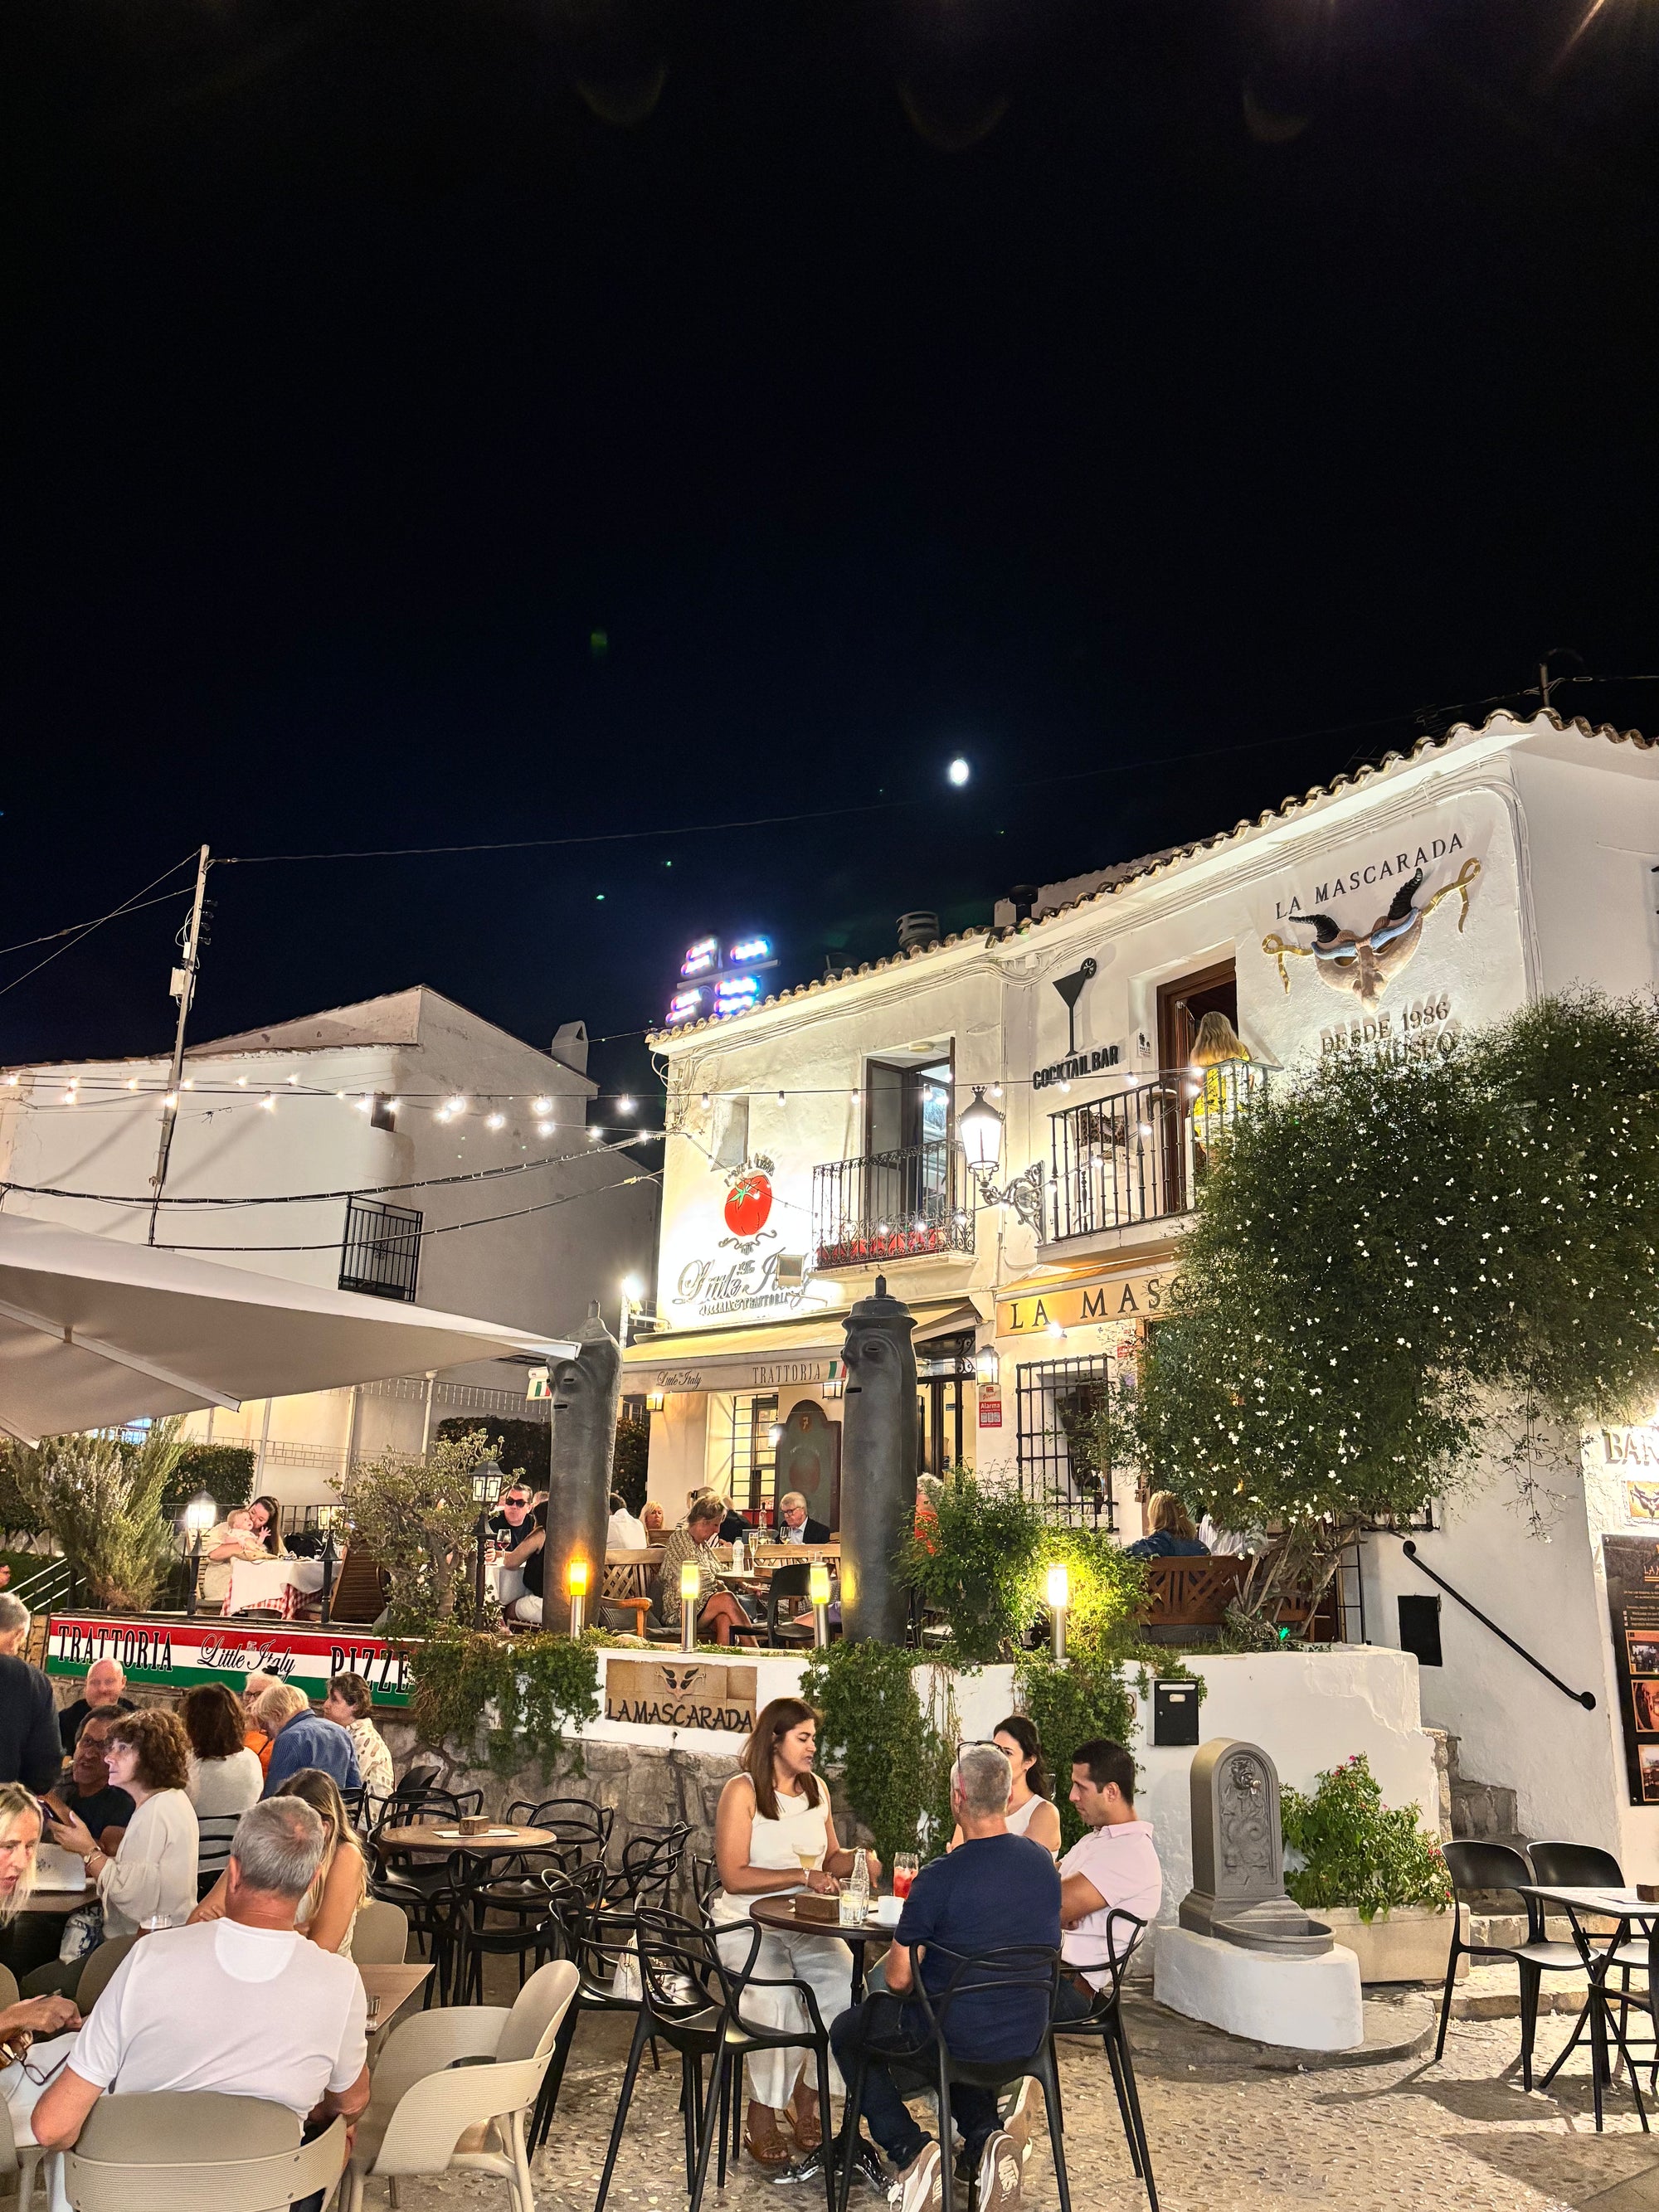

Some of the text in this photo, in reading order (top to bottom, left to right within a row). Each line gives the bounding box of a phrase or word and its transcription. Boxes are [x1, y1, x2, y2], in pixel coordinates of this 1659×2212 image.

[1275, 833, 1463, 920] LA MASCARADA
[1321, 1001, 1449, 1056] DESDE 1986
[1033, 1045, 1119, 1090] COCKTAIL BAR
[1010, 1299, 1052, 1330] LA
[655, 1370, 702, 1390] Little Italy
[752, 1363, 820, 1384] TRATTORIA
[980, 1402, 1000, 1410] Alarma
[58, 1625, 173, 1672] TRATTORIA
[197, 1633, 296, 1684] Little Italy
